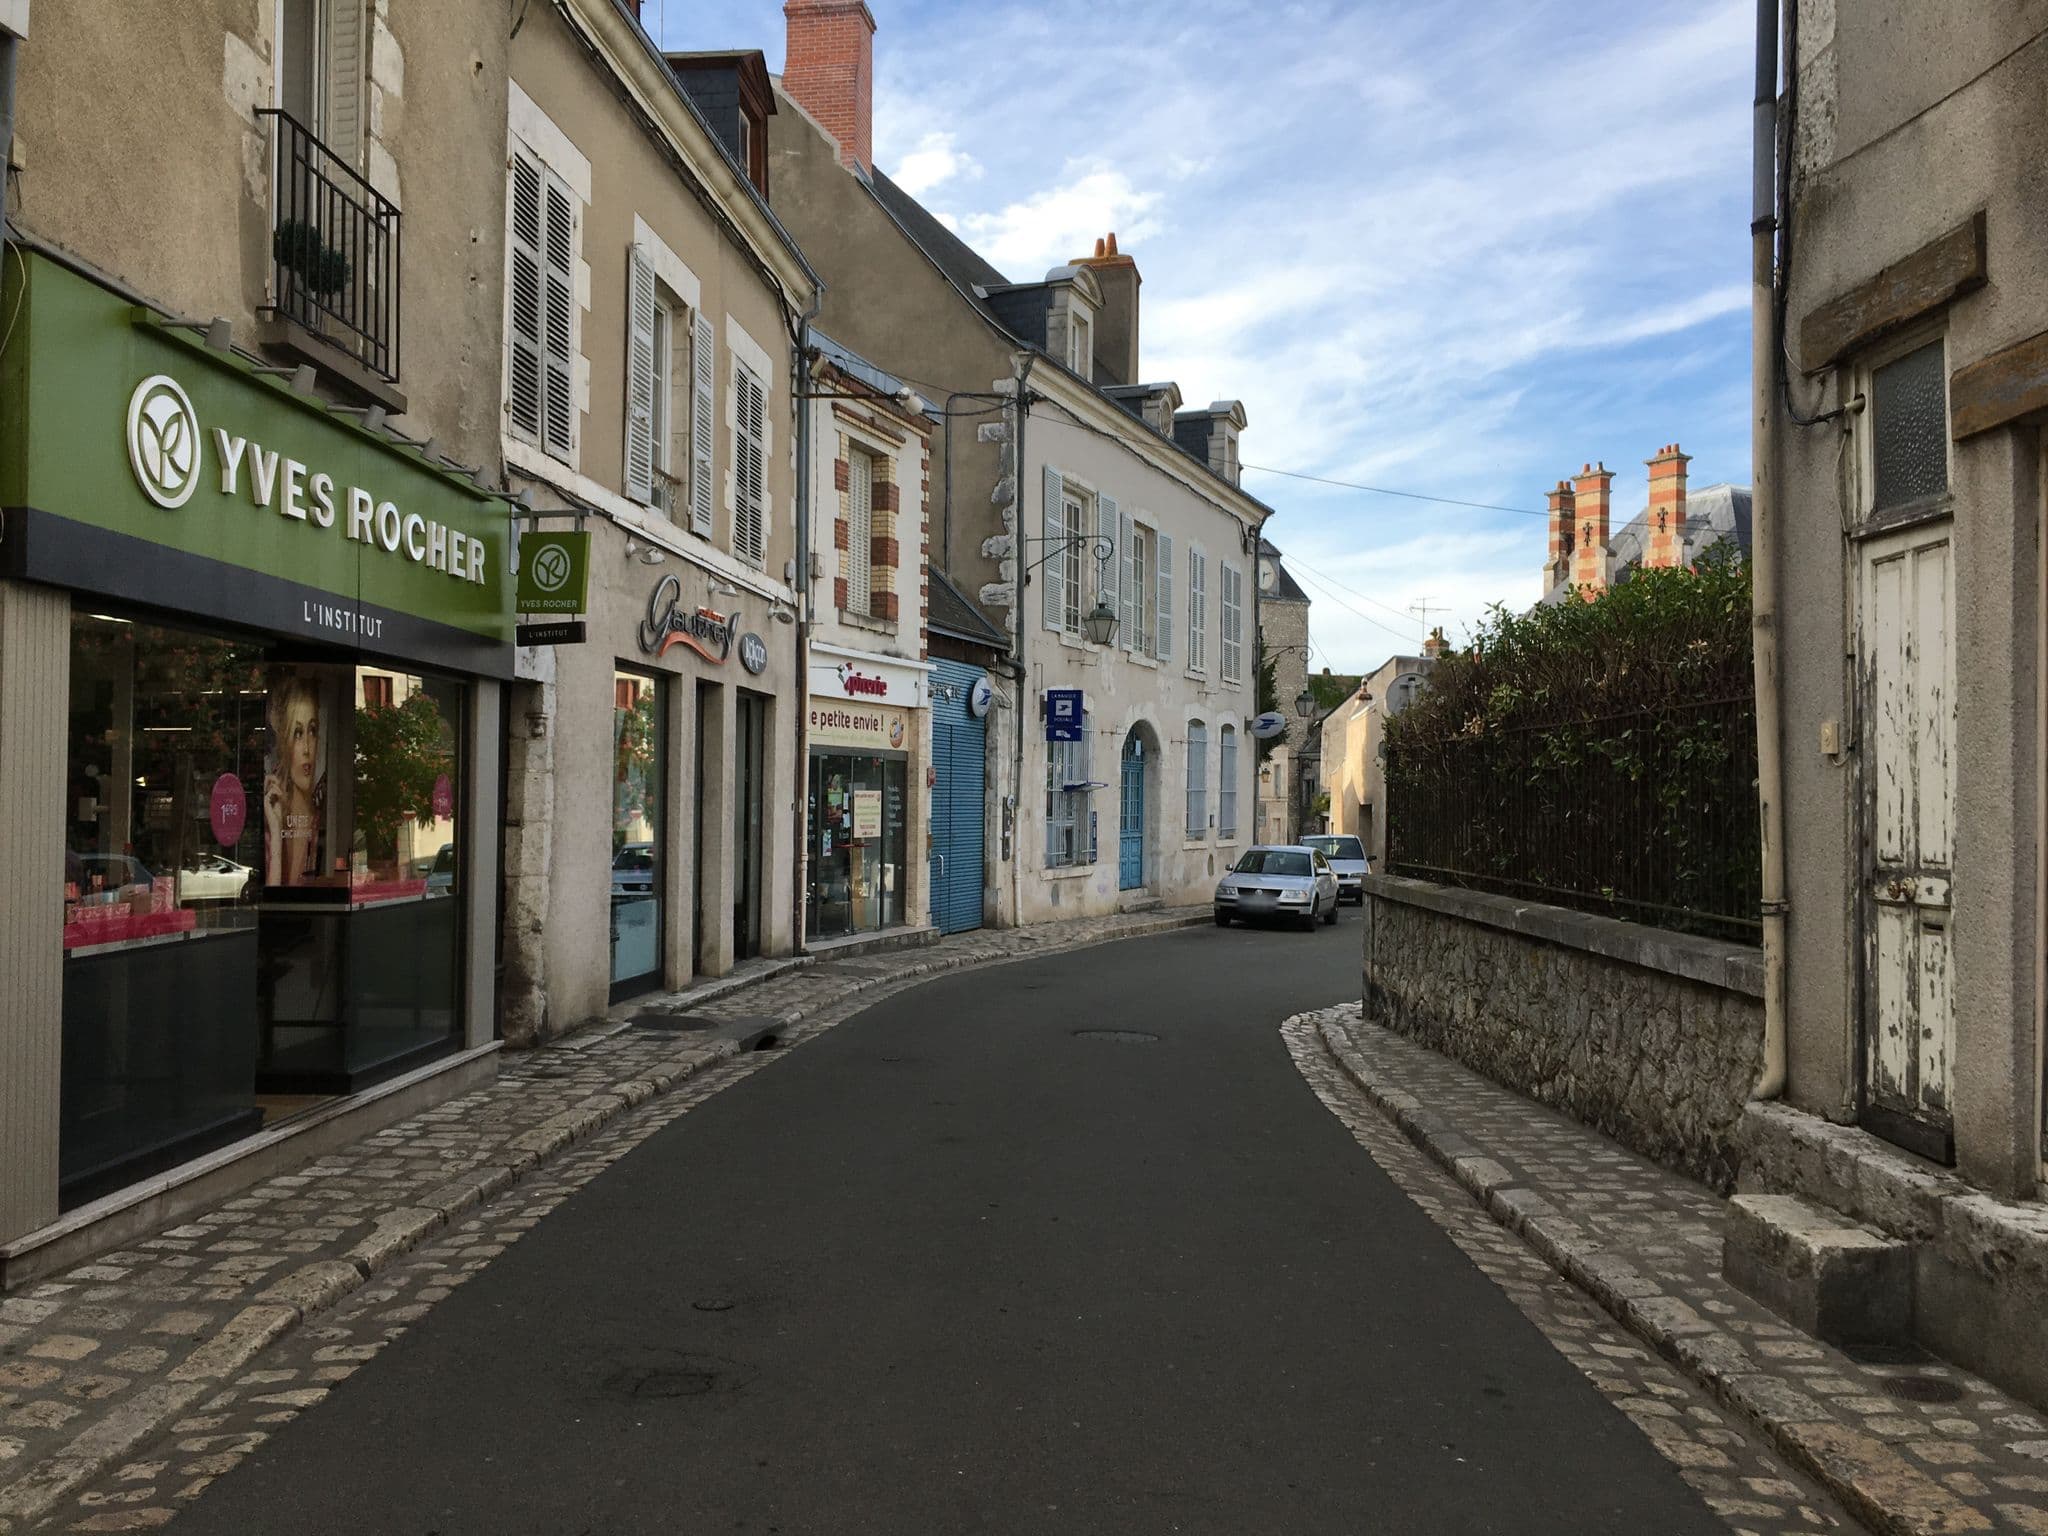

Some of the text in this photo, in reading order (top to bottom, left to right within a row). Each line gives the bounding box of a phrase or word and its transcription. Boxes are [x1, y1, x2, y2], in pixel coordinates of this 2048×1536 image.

[211, 427, 485, 585] YVES ROCHER
[521, 600, 578, 608] YVES ROCHER
[304, 601, 383, 638] L'INSTITUT
[529, 629, 568, 638] L'INSTITUT
[820, 710, 851, 731] petite
[853, 713, 879, 732] envie
